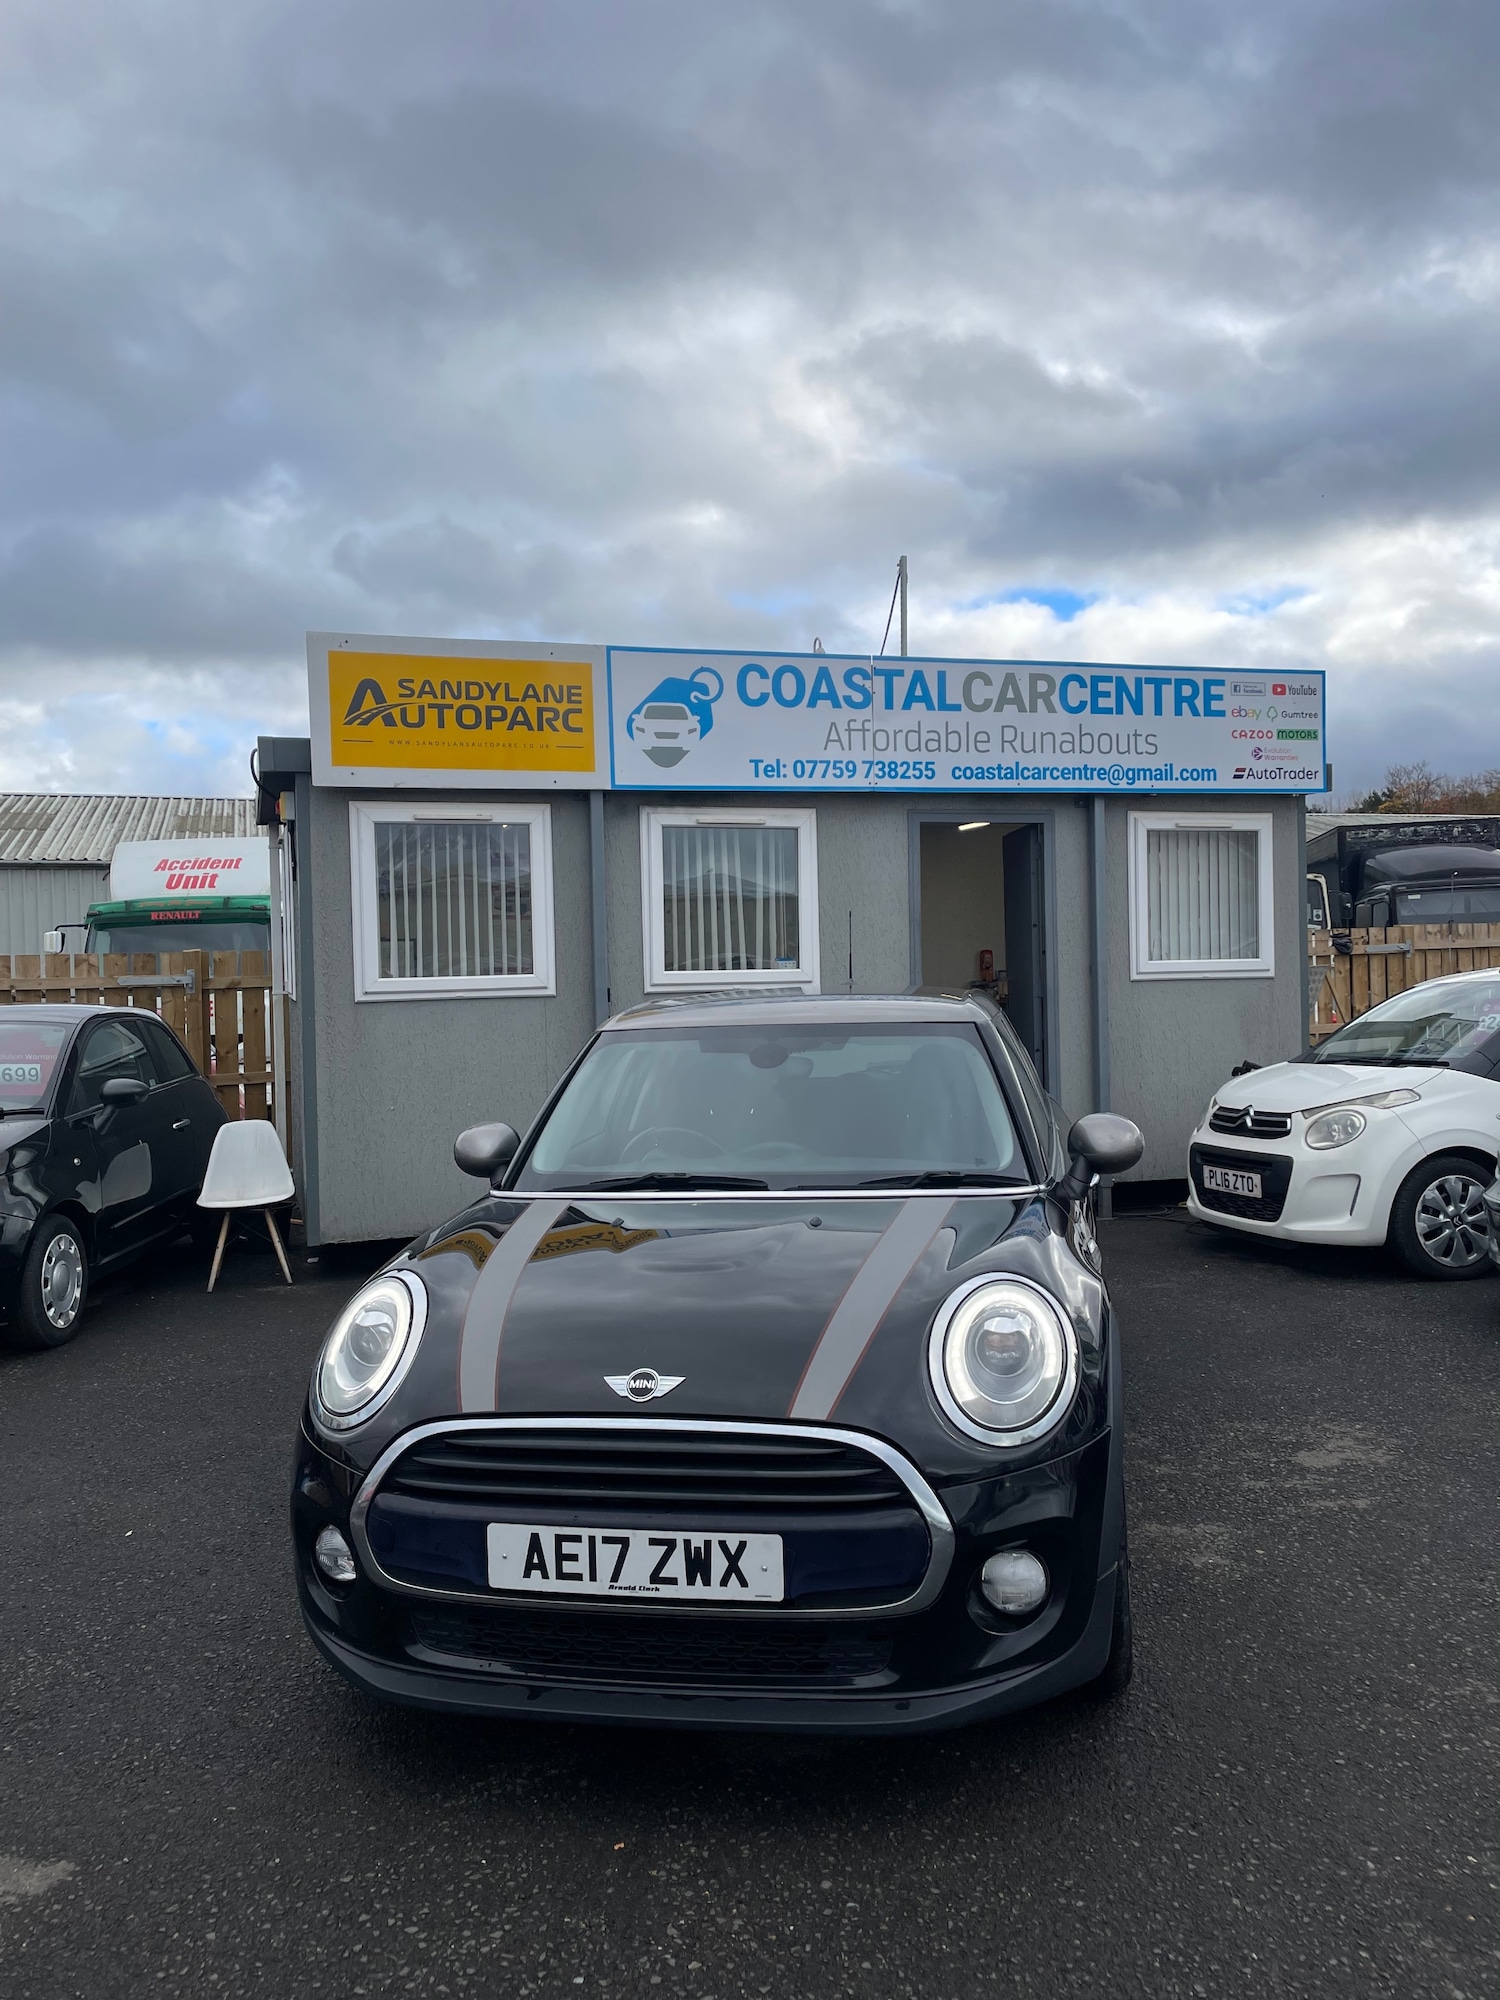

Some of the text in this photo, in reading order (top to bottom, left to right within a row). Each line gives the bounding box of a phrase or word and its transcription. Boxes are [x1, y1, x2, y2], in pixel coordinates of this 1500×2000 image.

[398, 678, 583, 705] SANDYLANE
[736, 663, 1226, 717] COASTALCARCENTRE
[1287, 684, 1317, 696] YouTube
[343, 677, 584, 733] AUTOPARC
[1231, 705, 1262, 721] ebay
[1281, 710, 1319, 719] Gumtree
[823, 718, 1159, 756] Affordable Runabouts
[1231, 729, 1274, 739] CAZOO
[749, 758, 1218, 786] Tel: 07759 738255 coastalcarcentre@gmail.com
[1246, 766, 1319, 780] AutoTrader
[153, 857, 243, 872] Accident
[165, 873, 220, 891] Unit
[150, 910, 202, 921] RENAULT
[1209, 1169, 1254, 1193] PL16 ZTO
[629, 1379, 655, 1389] MINI
[522, 1532, 749, 1588] AE17 ZWX
